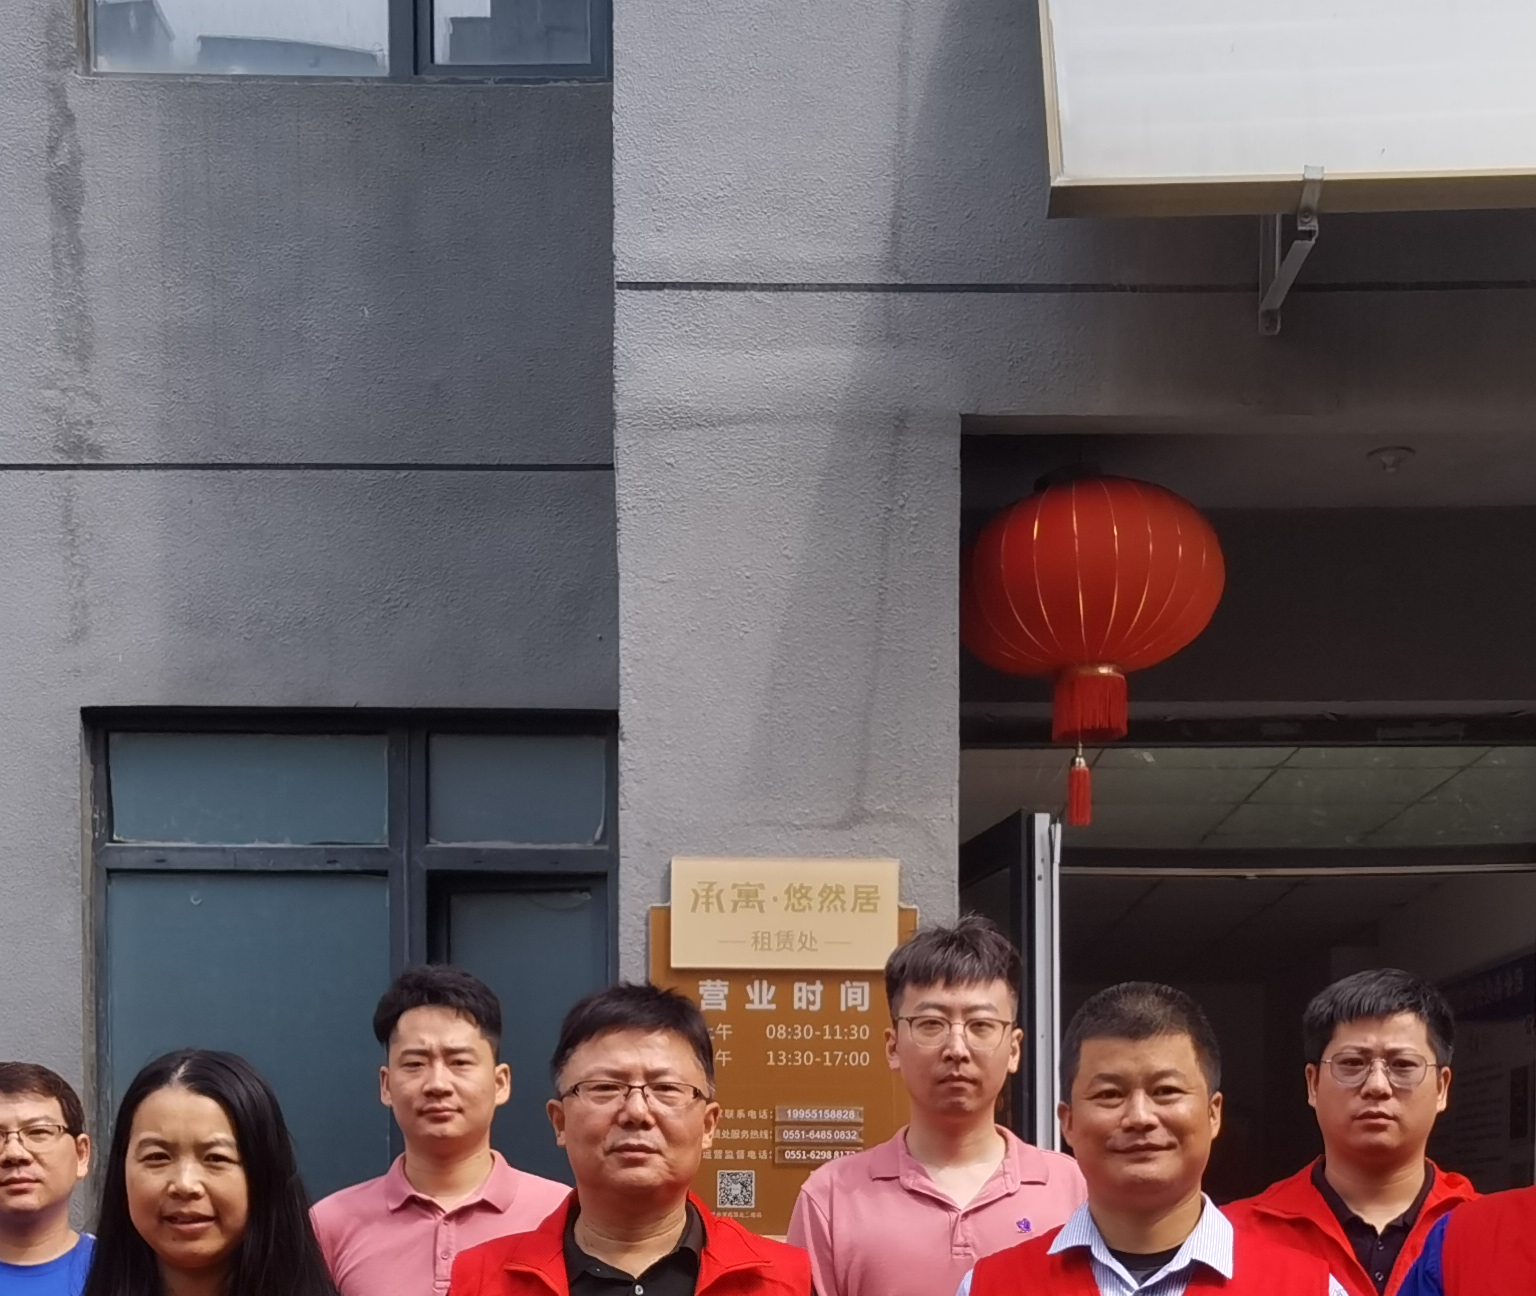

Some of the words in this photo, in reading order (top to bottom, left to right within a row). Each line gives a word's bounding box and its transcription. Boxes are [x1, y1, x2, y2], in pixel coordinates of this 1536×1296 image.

[750, 930, 819, 952] 租赁处
[698, 980, 871, 1012] 营业时间
[765, 1023, 870, 1041] 08:30-11:30
[765, 1050, 870, 1067] 13:30-17:00
